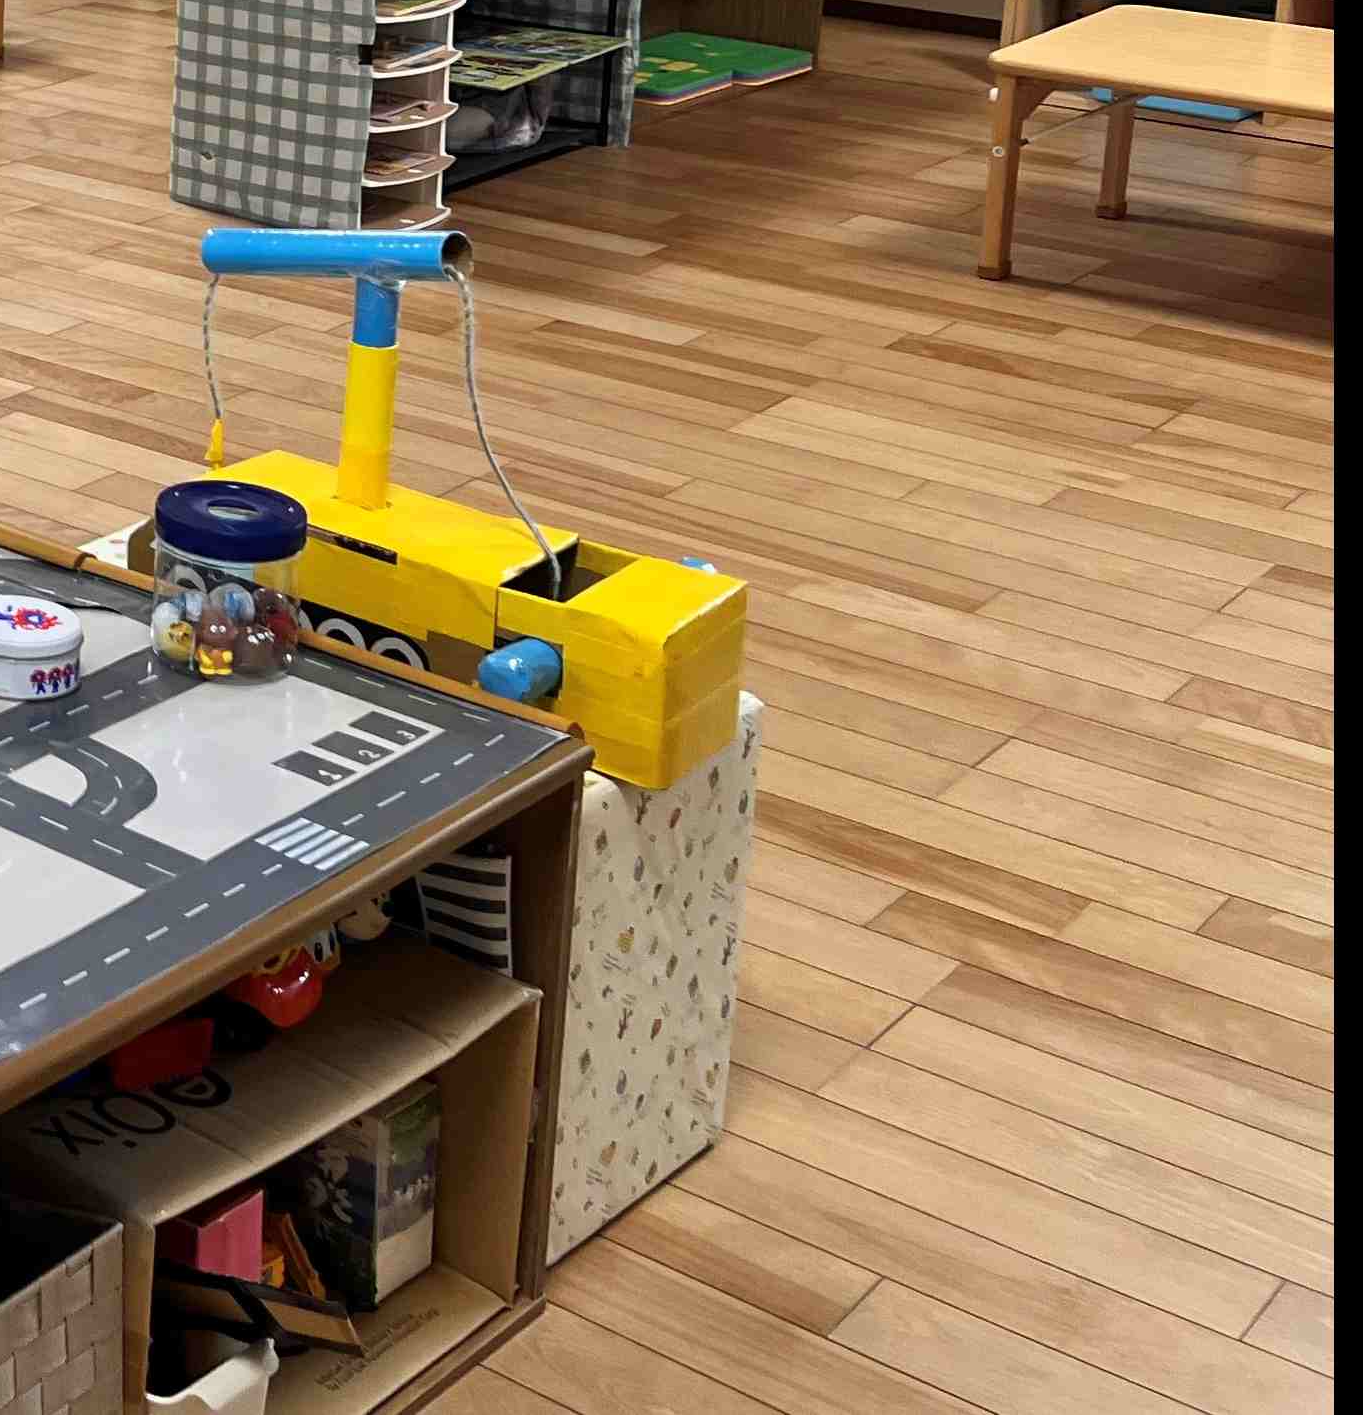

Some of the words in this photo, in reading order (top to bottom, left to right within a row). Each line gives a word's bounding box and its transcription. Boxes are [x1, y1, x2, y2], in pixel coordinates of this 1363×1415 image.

[396, 729, 416, 740] 3
[358, 749, 381, 759] 2
[317, 769, 343, 781] 1
